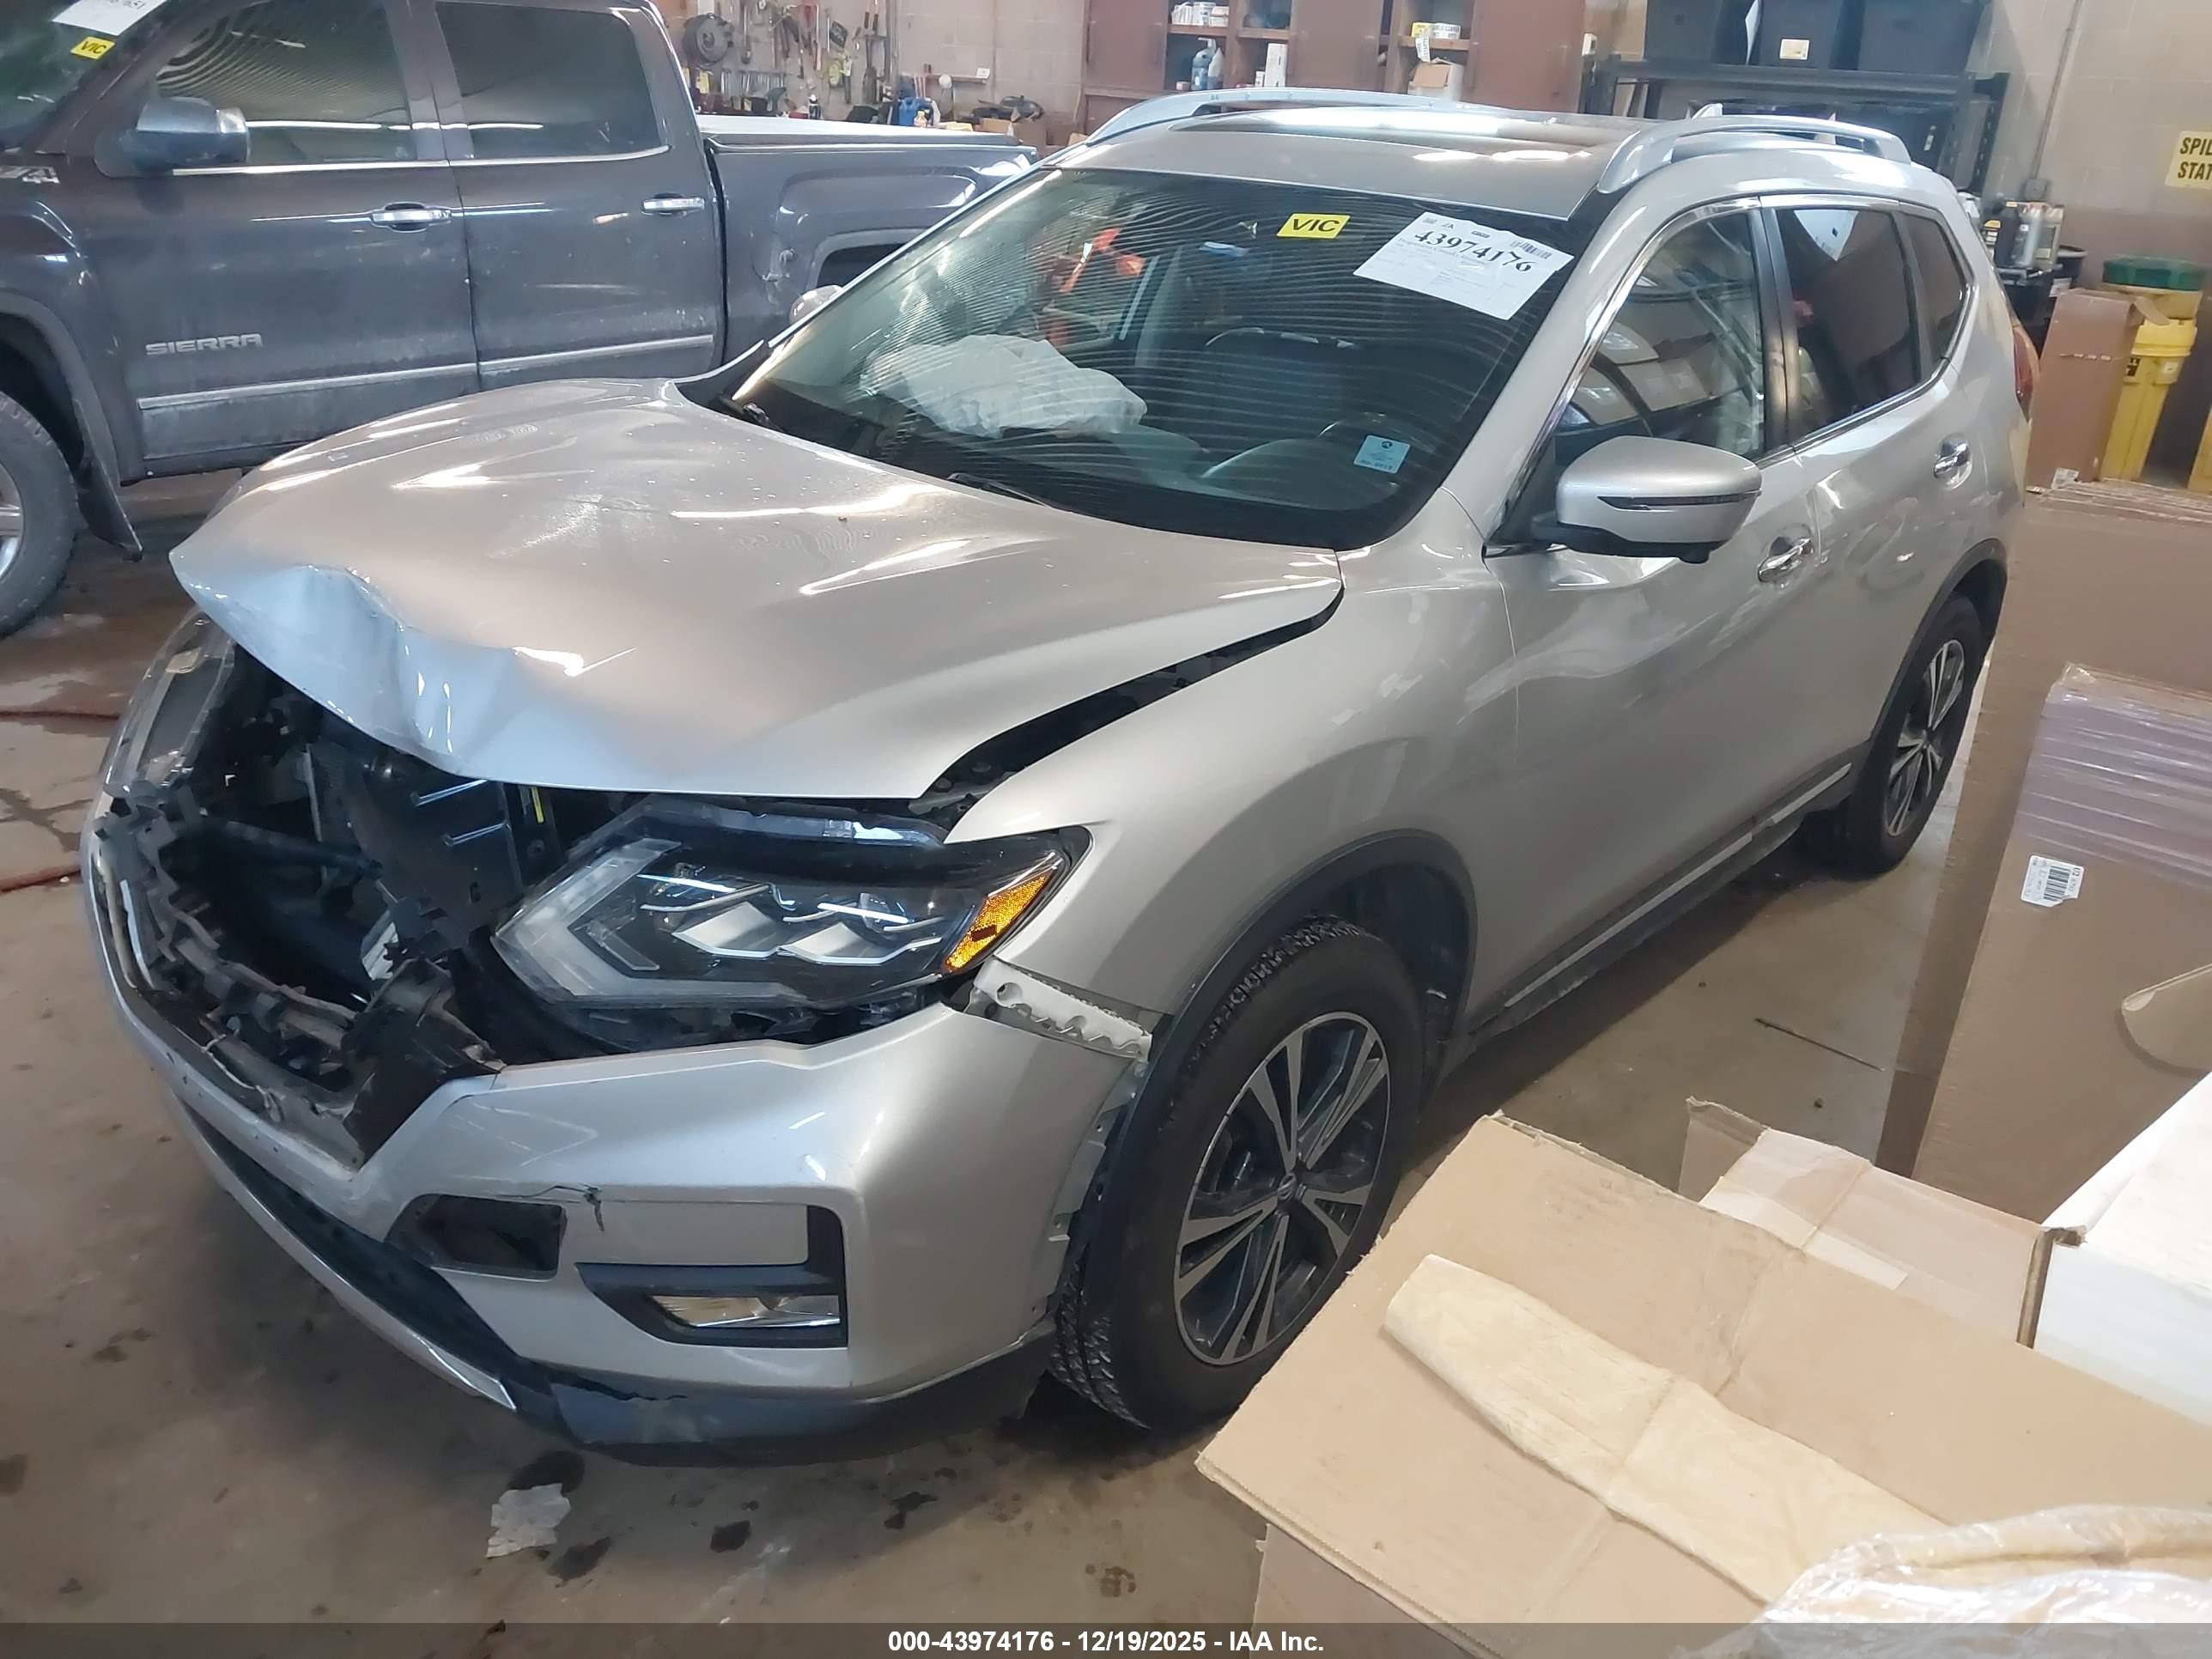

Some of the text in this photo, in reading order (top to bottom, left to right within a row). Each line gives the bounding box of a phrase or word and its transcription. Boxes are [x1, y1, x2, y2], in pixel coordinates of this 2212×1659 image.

[81, 40, 106, 54] VIC
[1292, 218, 1340, 232] VIC
[1414, 230, 1536, 272] 43974176
[145, 332, 263, 356] SIERRA
